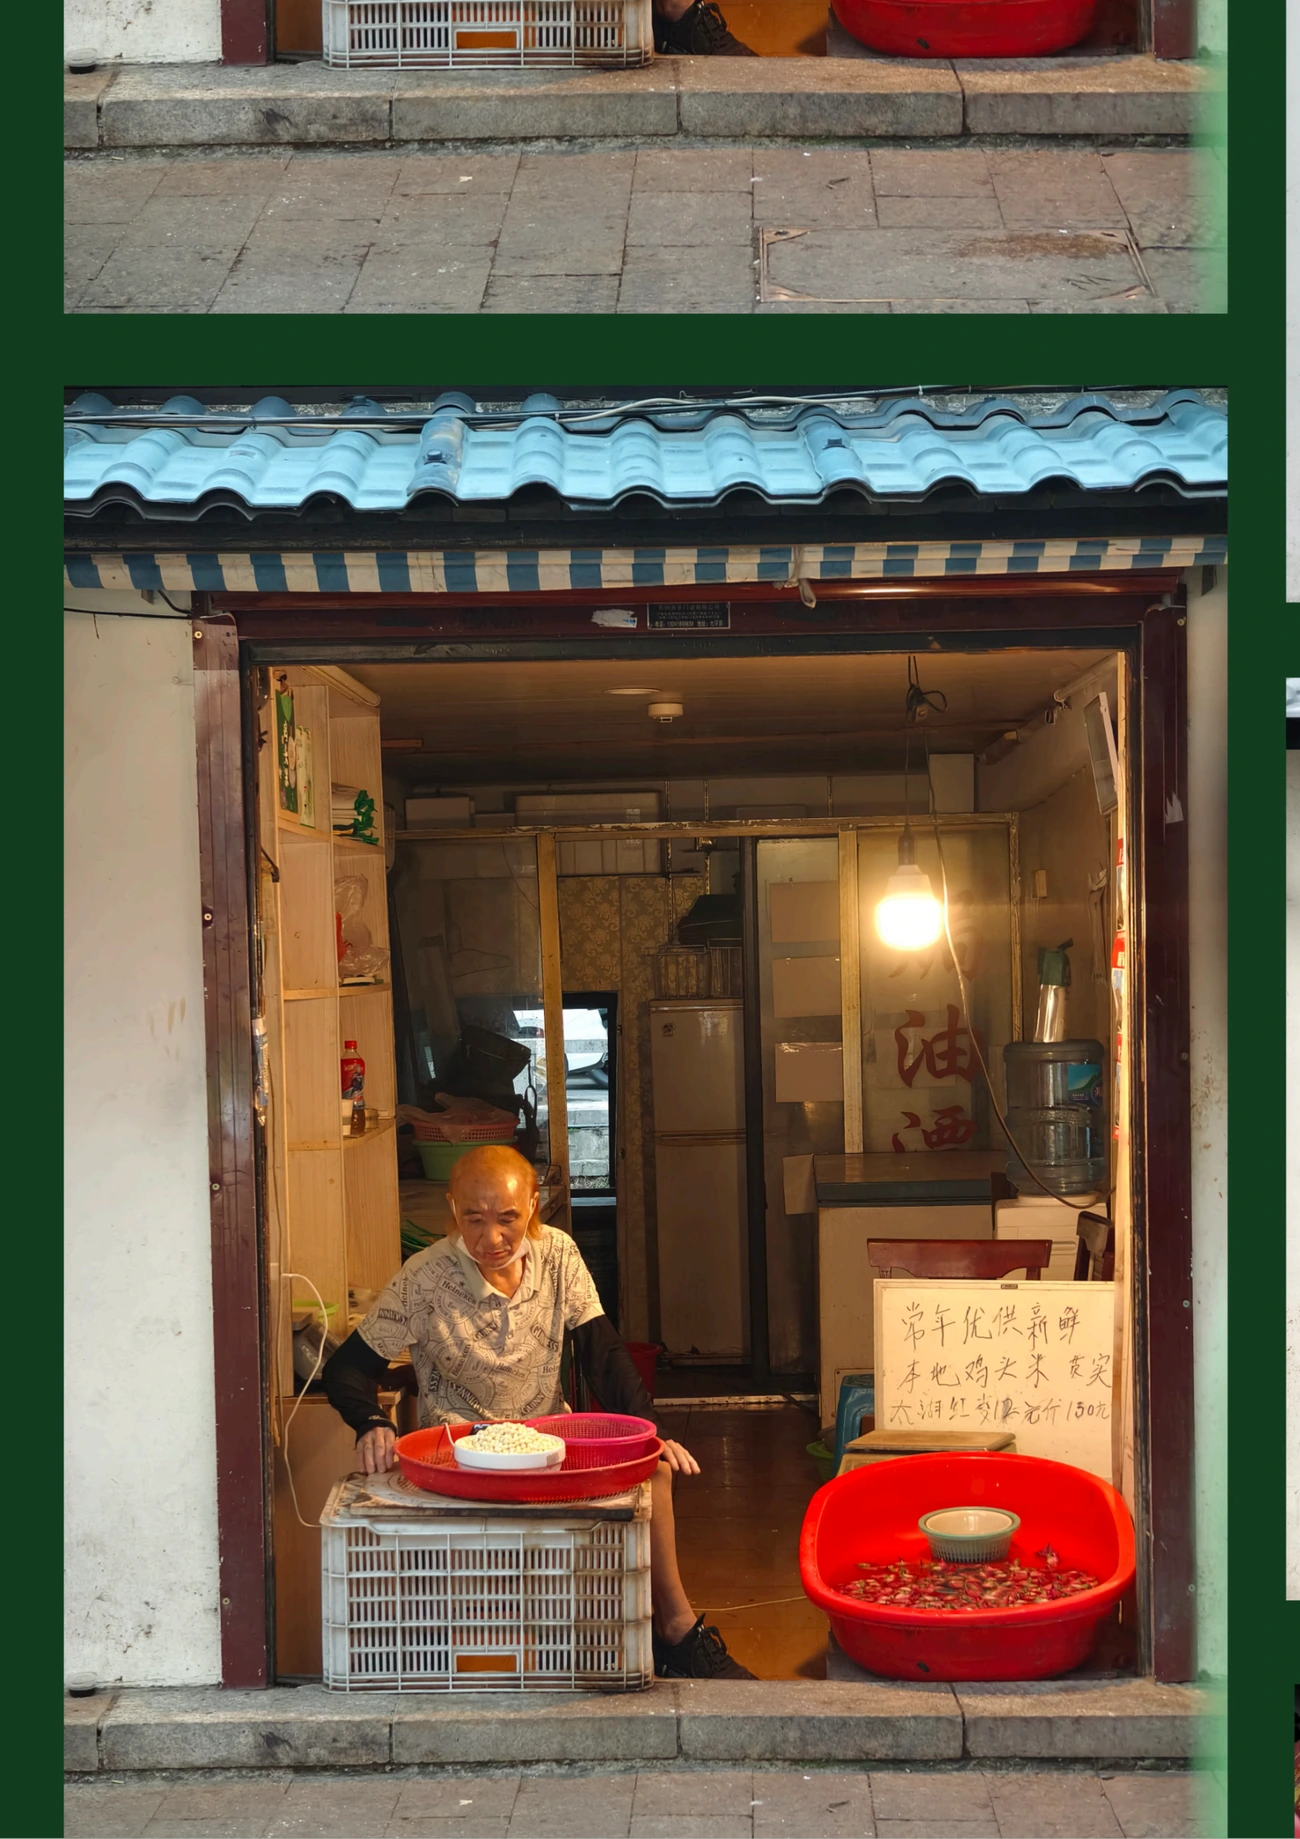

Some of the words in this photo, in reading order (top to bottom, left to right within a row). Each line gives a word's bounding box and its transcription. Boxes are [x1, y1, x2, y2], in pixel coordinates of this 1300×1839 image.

[441, 1279, 477, 1306] Heineken
[901, 1301, 1081, 1350] 常年优供新鲜
[897, 1353, 1049, 1394] 本地鸡头米
